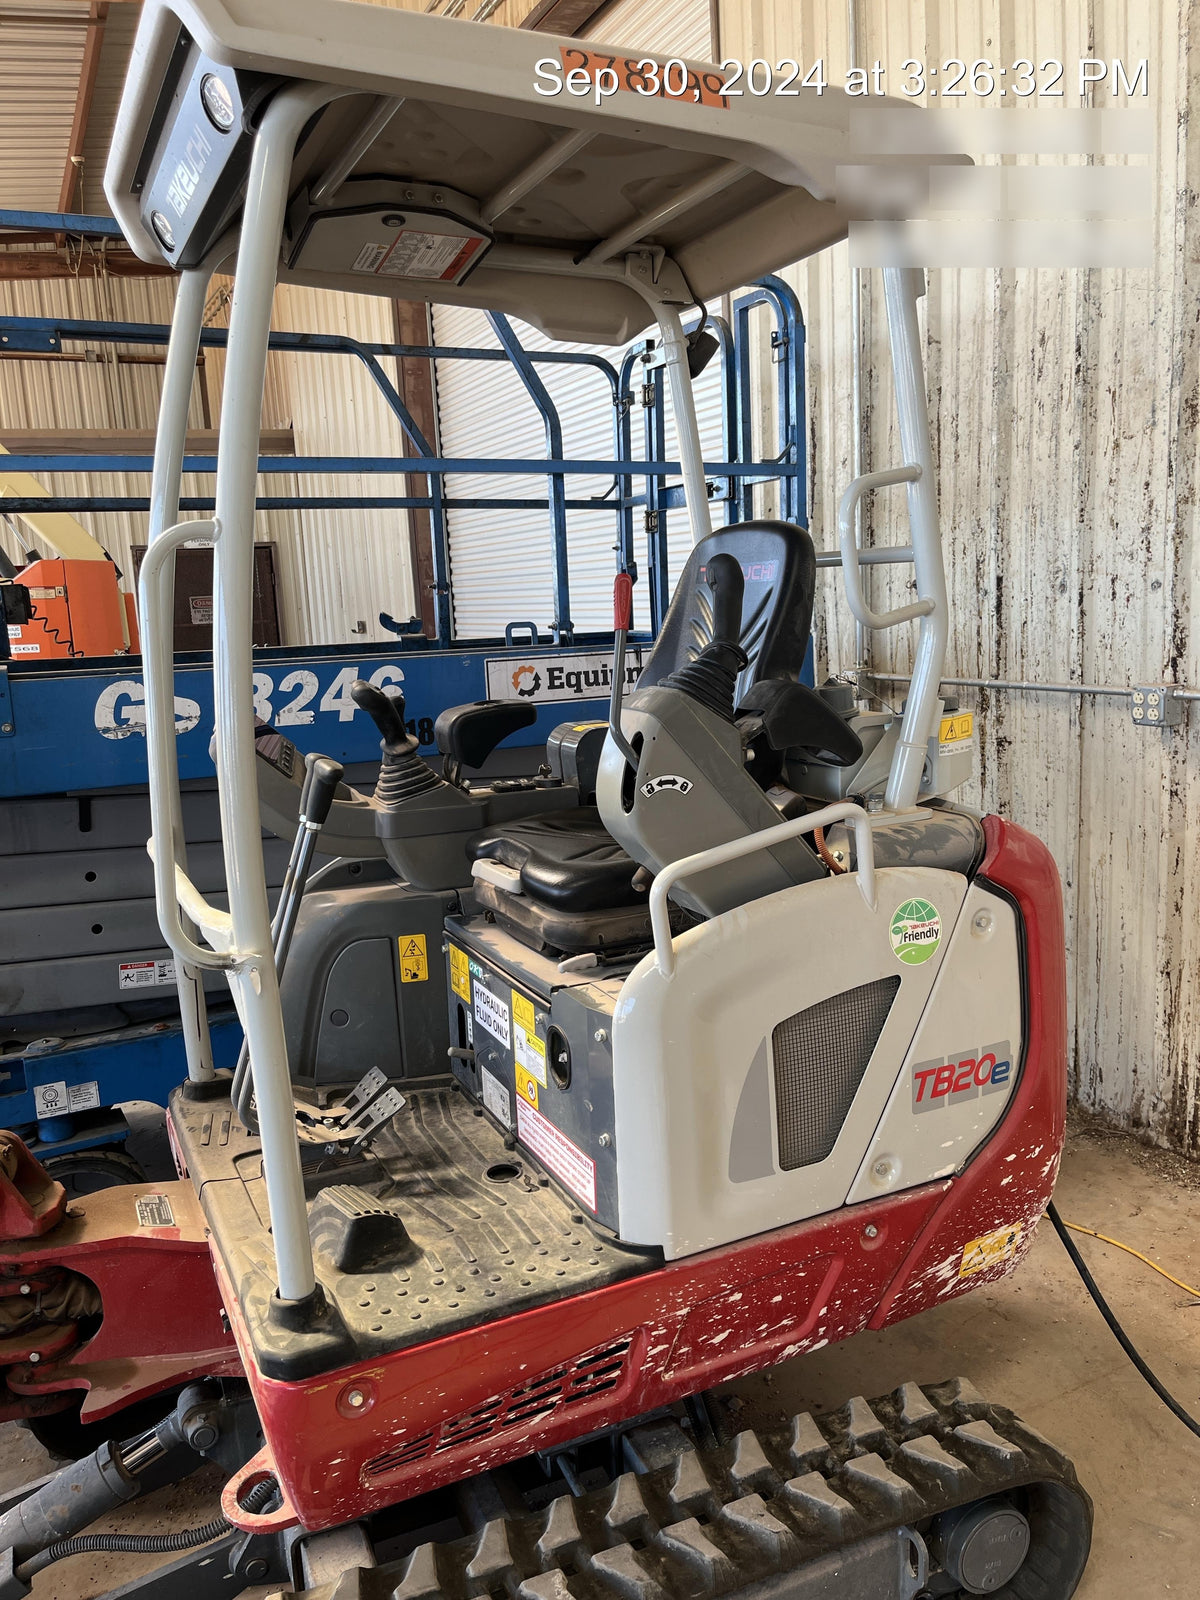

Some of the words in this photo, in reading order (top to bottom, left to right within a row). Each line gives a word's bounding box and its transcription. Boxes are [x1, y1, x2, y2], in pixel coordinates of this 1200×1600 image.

[903, 926, 940, 943] Friendly
[474, 985, 508, 1022] HYDRAULIC
[475, 1004, 493, 1028] FLUID
[492, 1019, 509, 1041] ONLY
[914, 1052, 1011, 1103] TB20e
